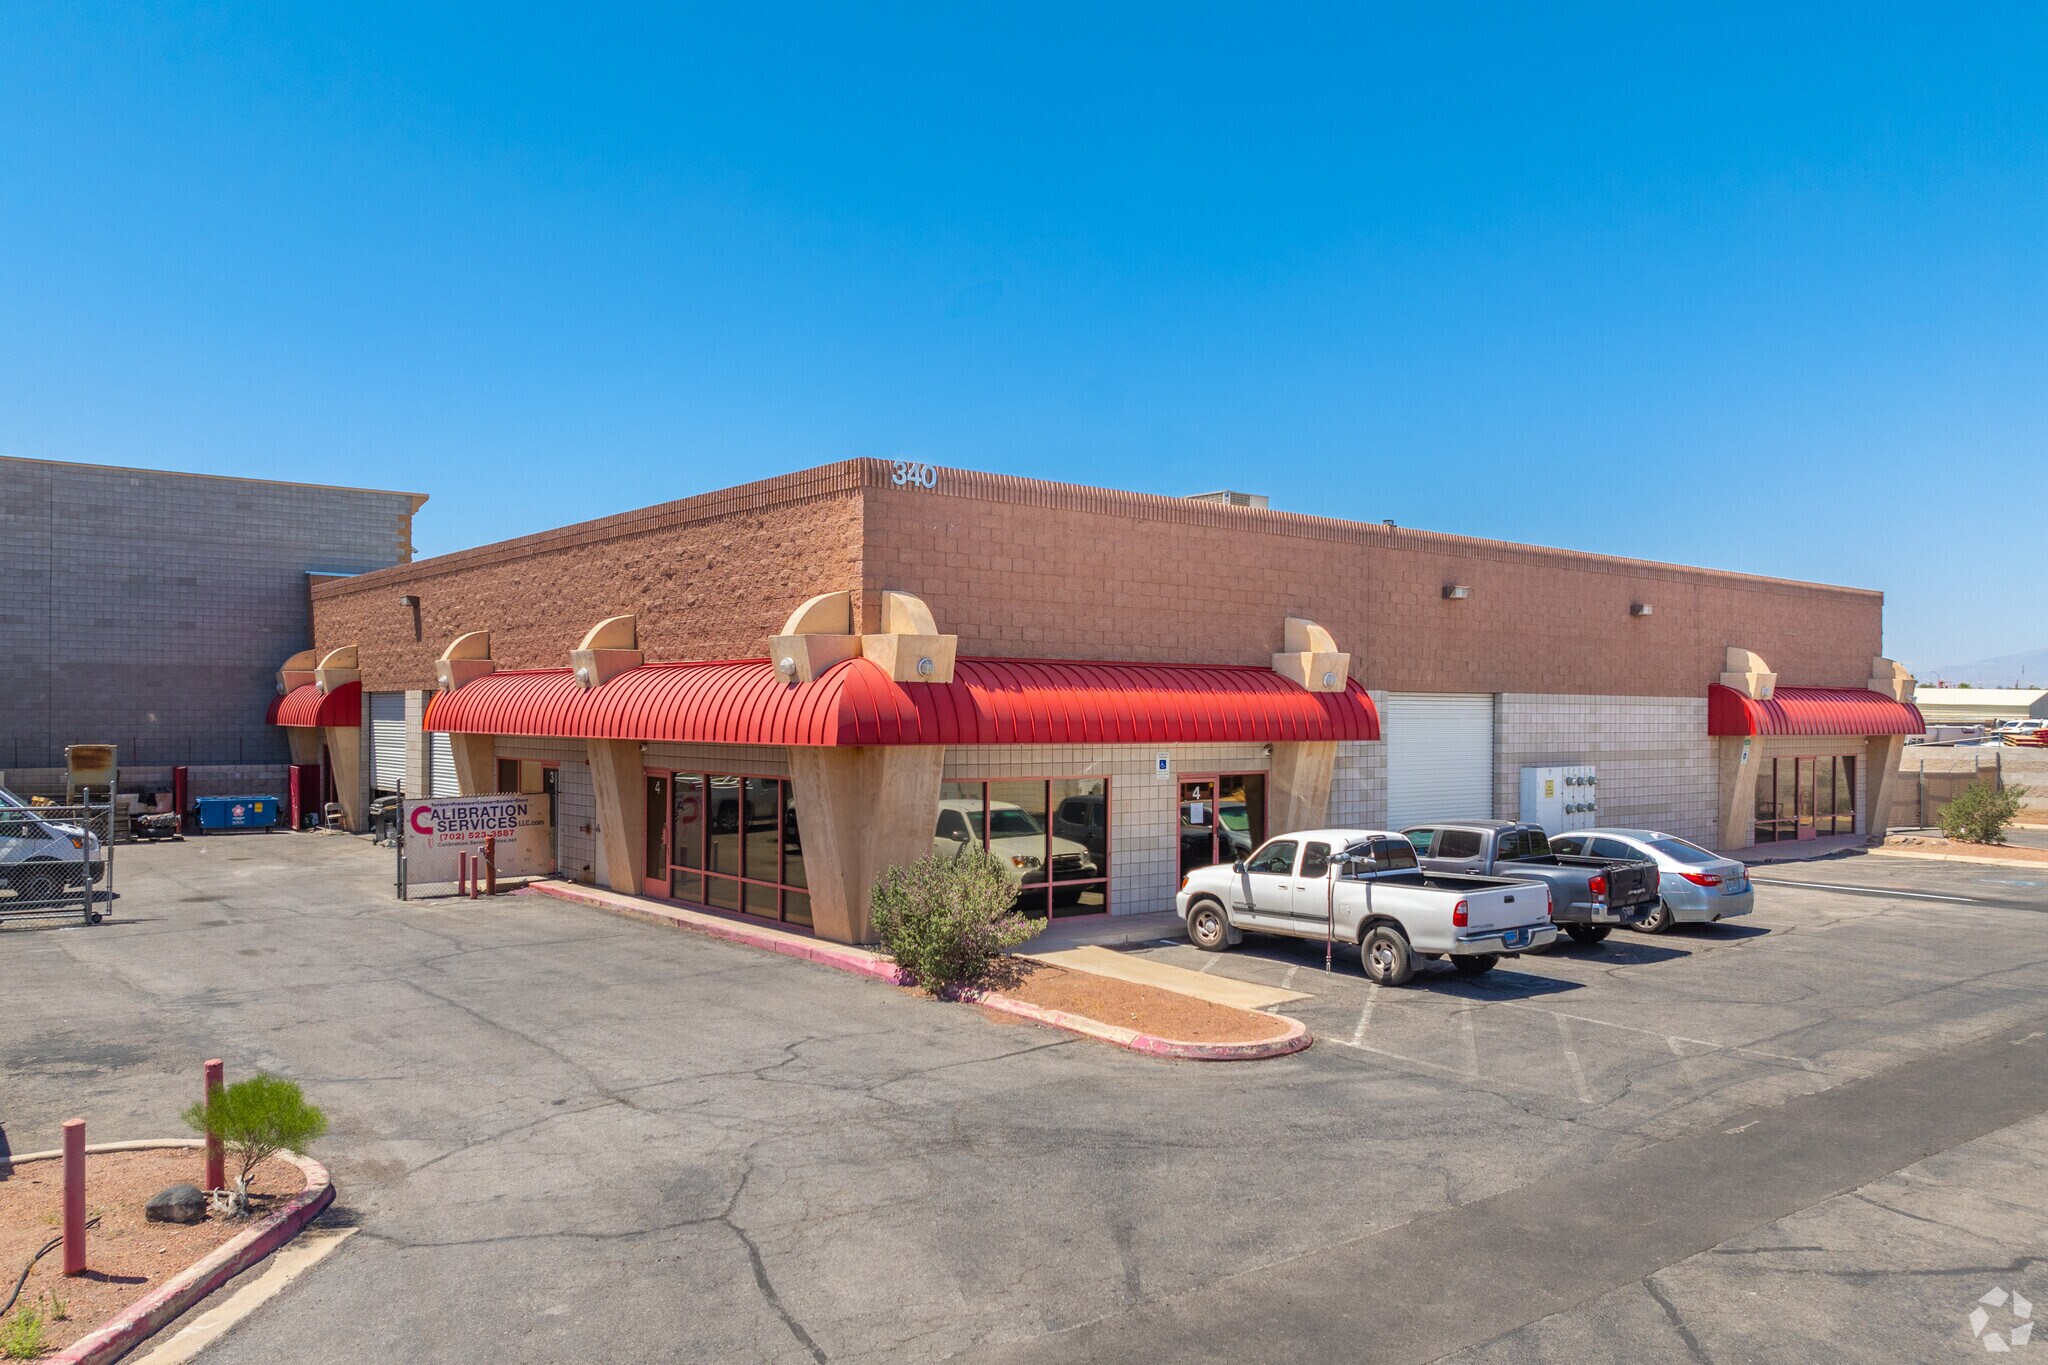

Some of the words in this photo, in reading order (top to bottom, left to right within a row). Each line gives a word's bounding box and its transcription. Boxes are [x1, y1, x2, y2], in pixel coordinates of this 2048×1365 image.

[892, 460, 937, 489] 340
[549, 771, 555, 784] 3
[654, 780, 661, 795] 4
[1192, 786, 1201, 800] 4
[437, 816, 518, 832] SERVICES
[518, 819, 545, 827] LLC.com
[439, 832, 465, 842] (702)
